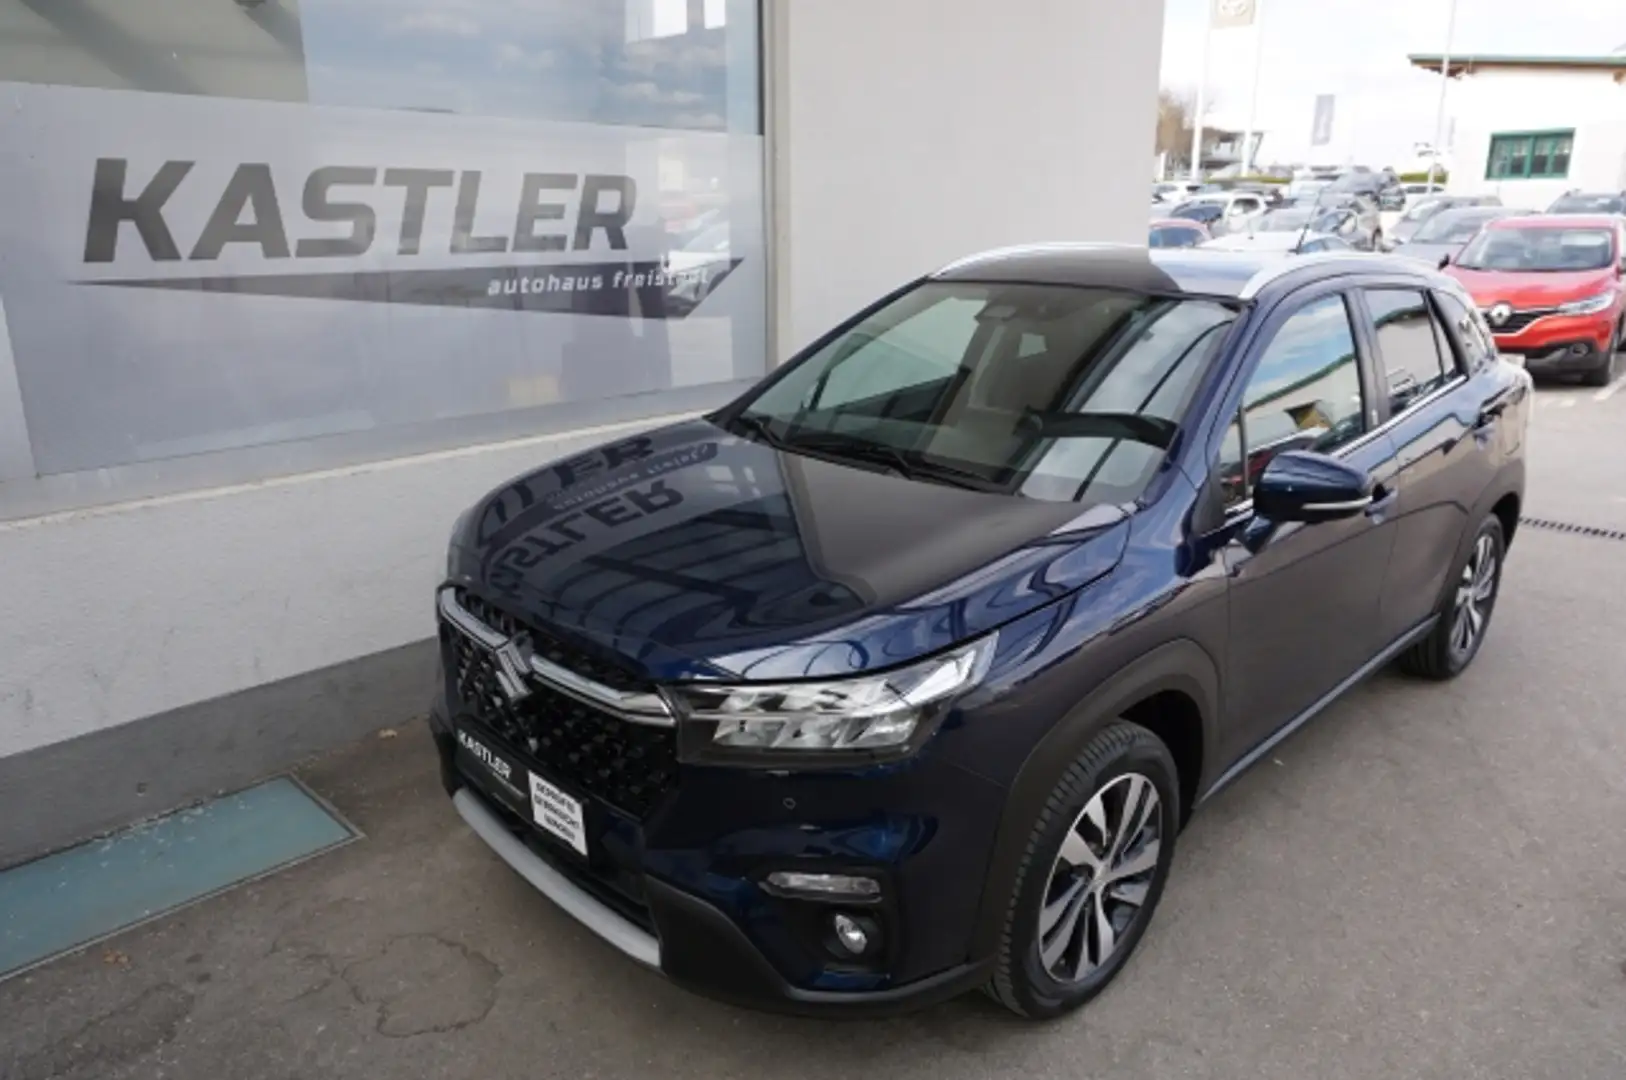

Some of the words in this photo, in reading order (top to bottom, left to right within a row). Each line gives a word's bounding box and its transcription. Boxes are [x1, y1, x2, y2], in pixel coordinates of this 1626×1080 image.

[83, 157, 637, 263] KASTLER
[487, 273, 604, 296] autohaus
[457, 729, 512, 779] KASTLER
